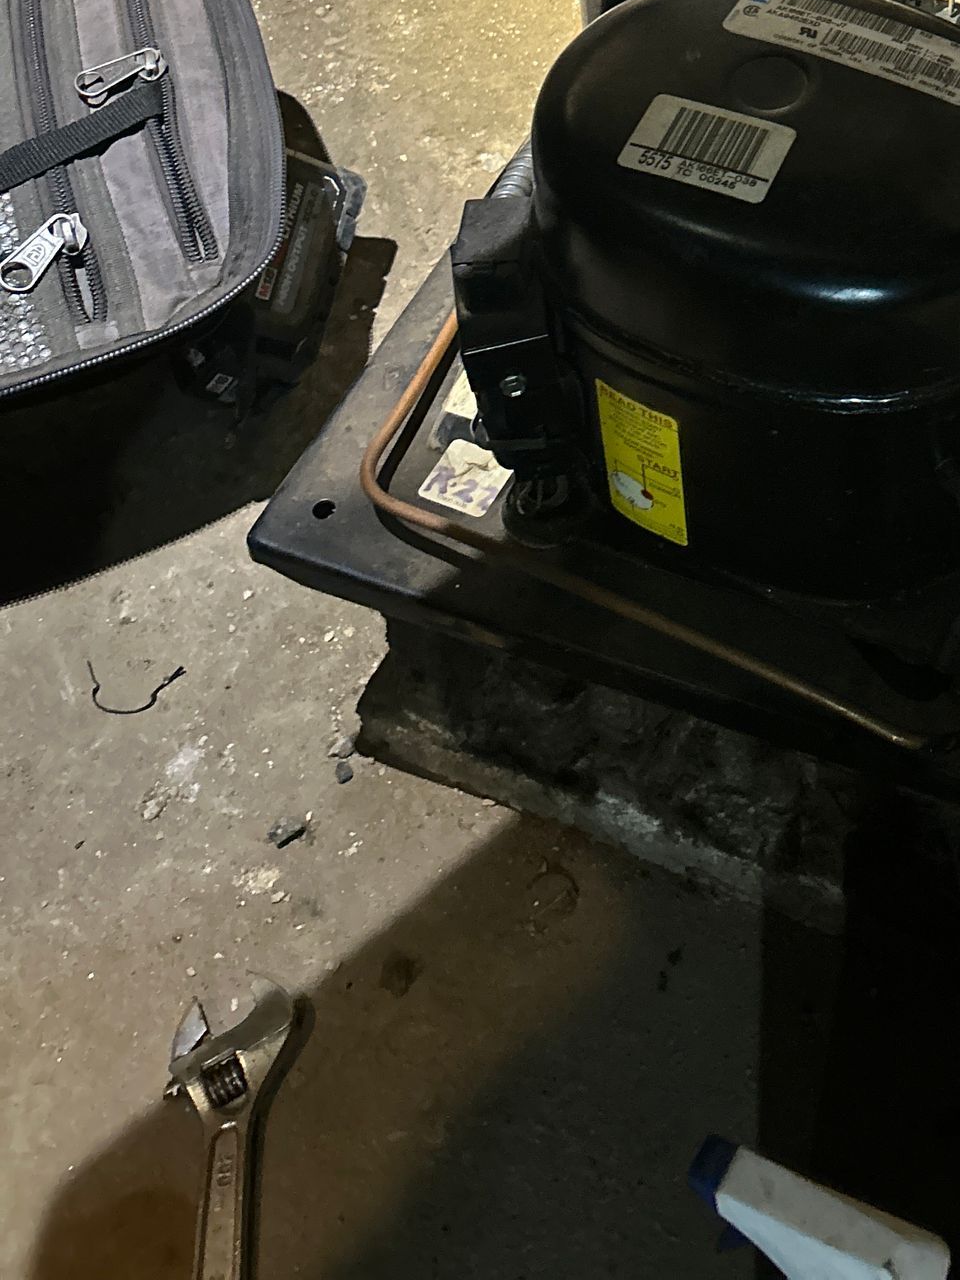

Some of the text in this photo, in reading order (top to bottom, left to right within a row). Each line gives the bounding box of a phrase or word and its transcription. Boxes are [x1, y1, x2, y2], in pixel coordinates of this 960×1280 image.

[637, 149, 671, 171] 5575
[676, 165, 693, 176] TC
[289, 224, 308, 271] OUTPUT
[599, 384, 674, 428] READ THIS
[636, 454, 680, 481] START
